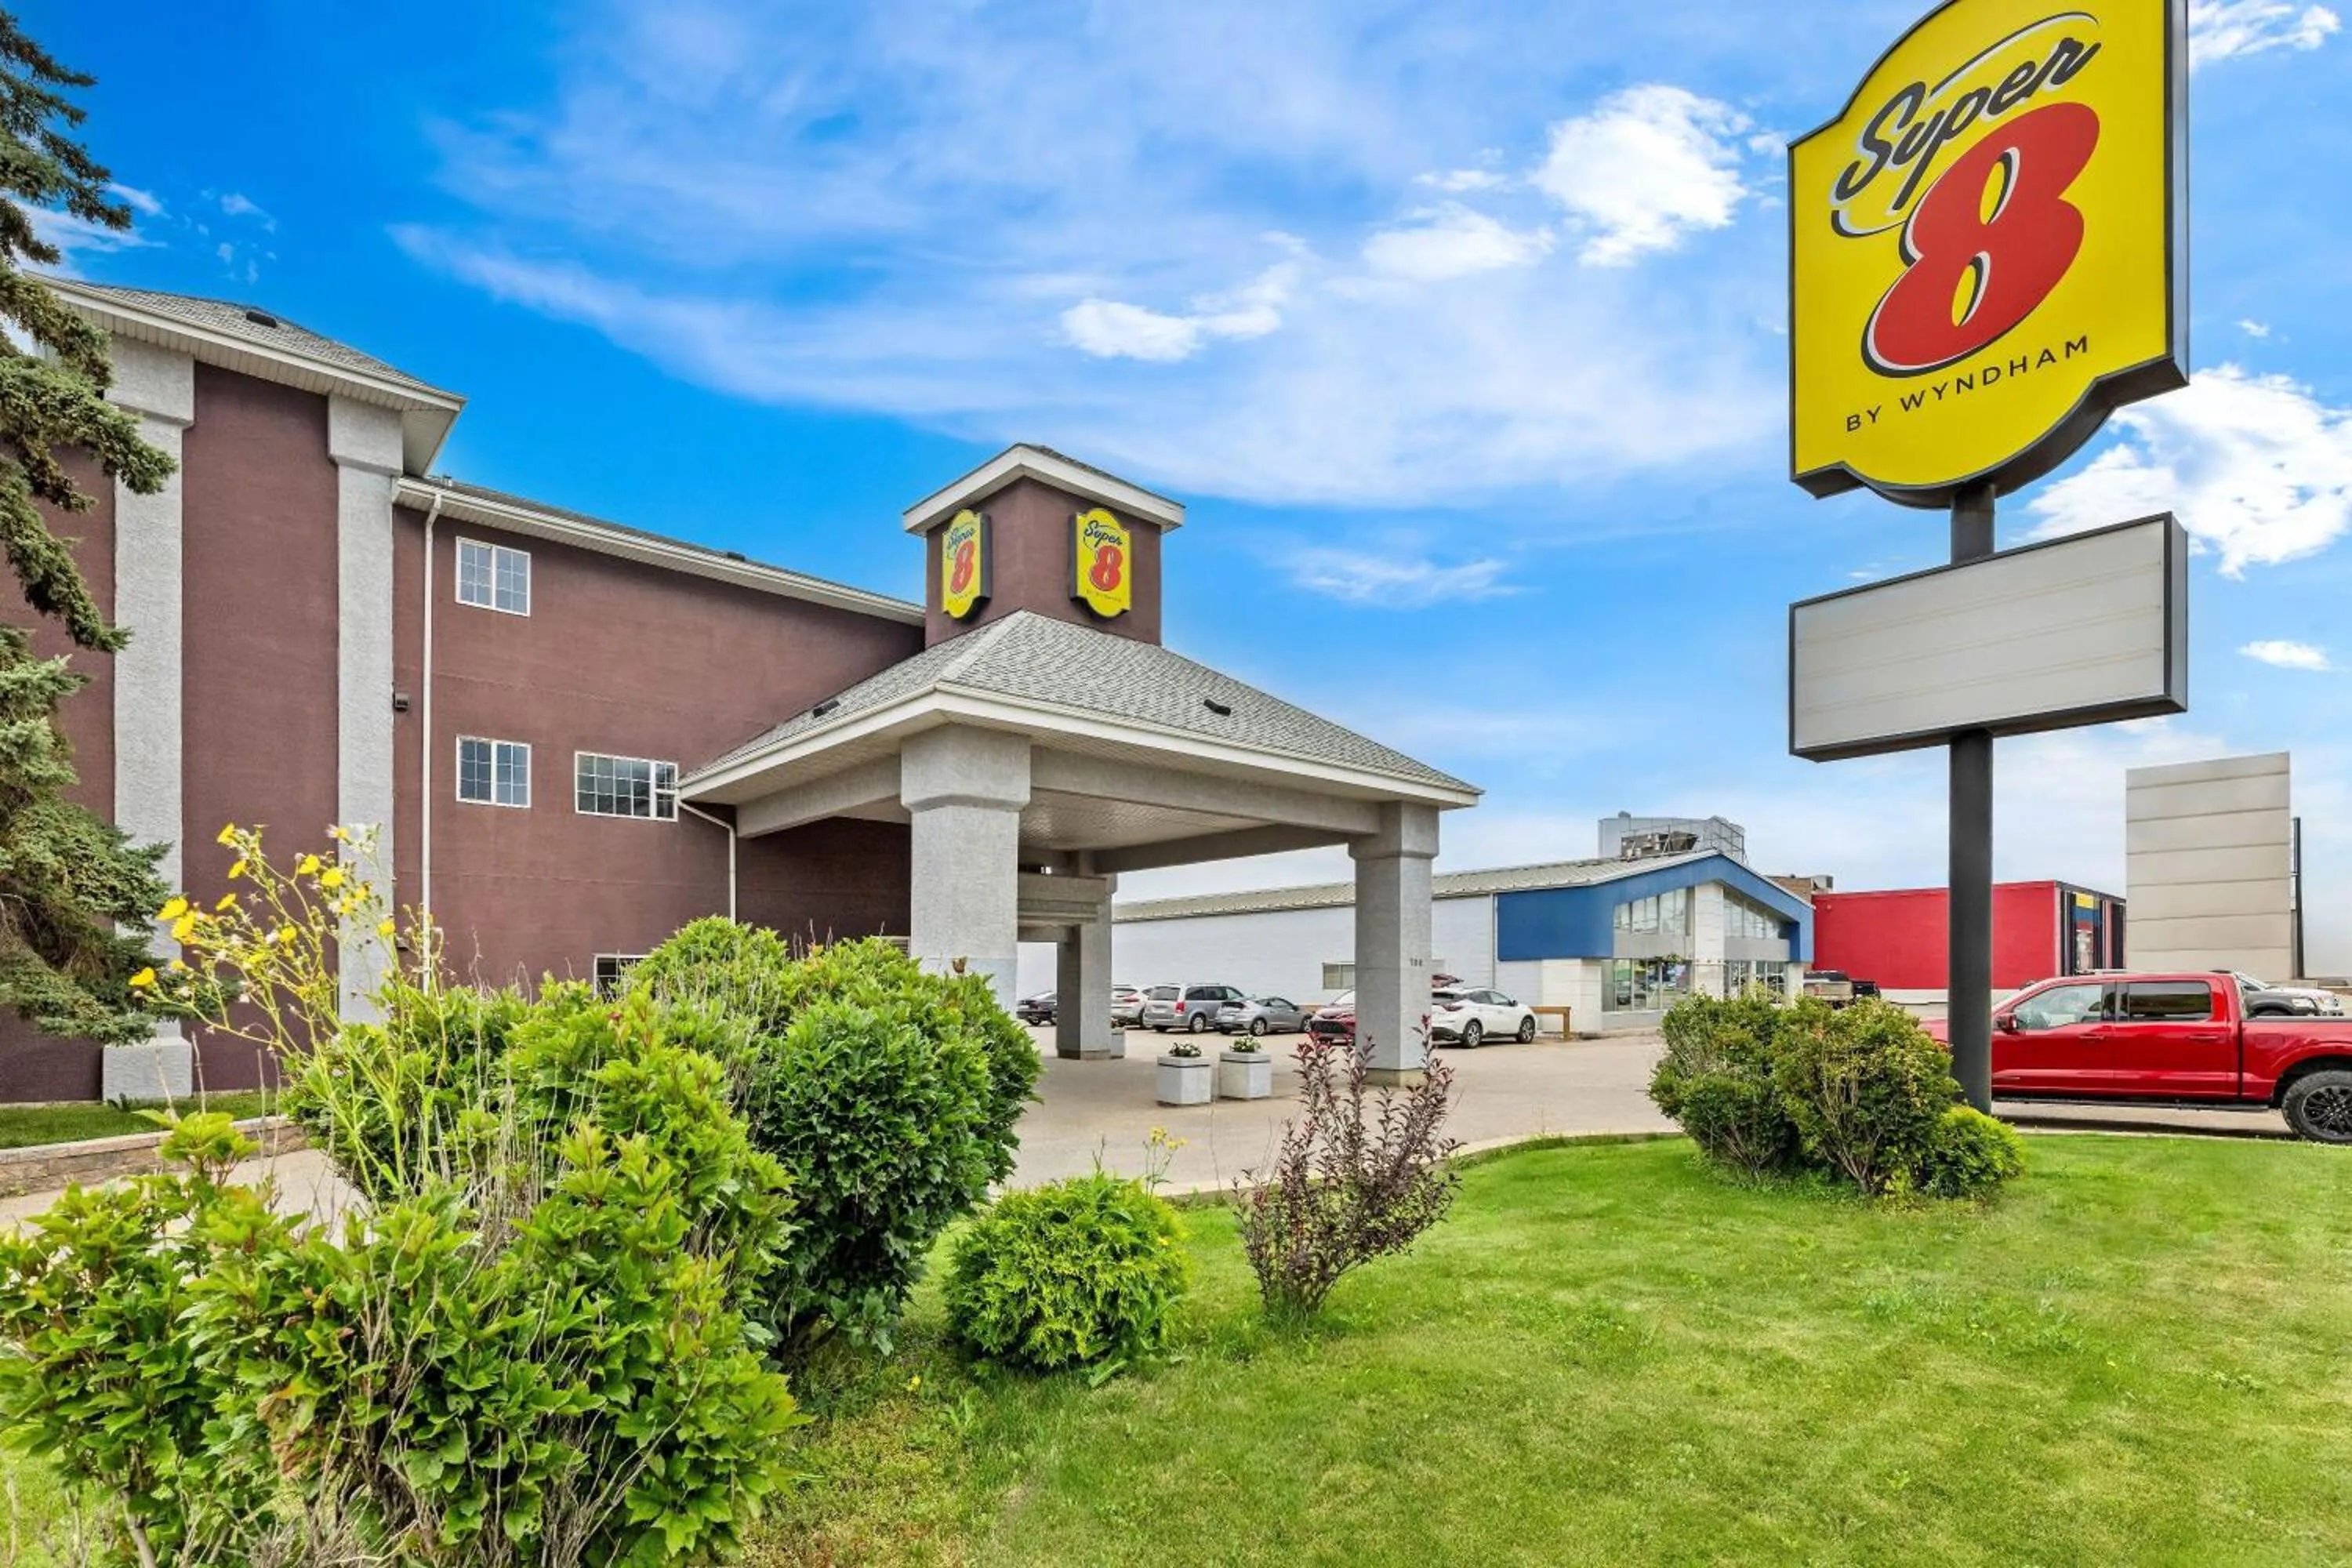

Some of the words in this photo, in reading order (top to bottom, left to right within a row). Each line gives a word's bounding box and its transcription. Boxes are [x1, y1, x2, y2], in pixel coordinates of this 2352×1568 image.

[1831, 37, 2102, 212] Super
[1860, 102, 2101, 378] 8
[1846, 405, 1882, 432] BY
[1900, 335, 2088, 412] WYNDHAM
[950, 540, 975, 593] 8
[1084, 520, 1123, 548] Super
[1089, 545, 1123, 591] 8
